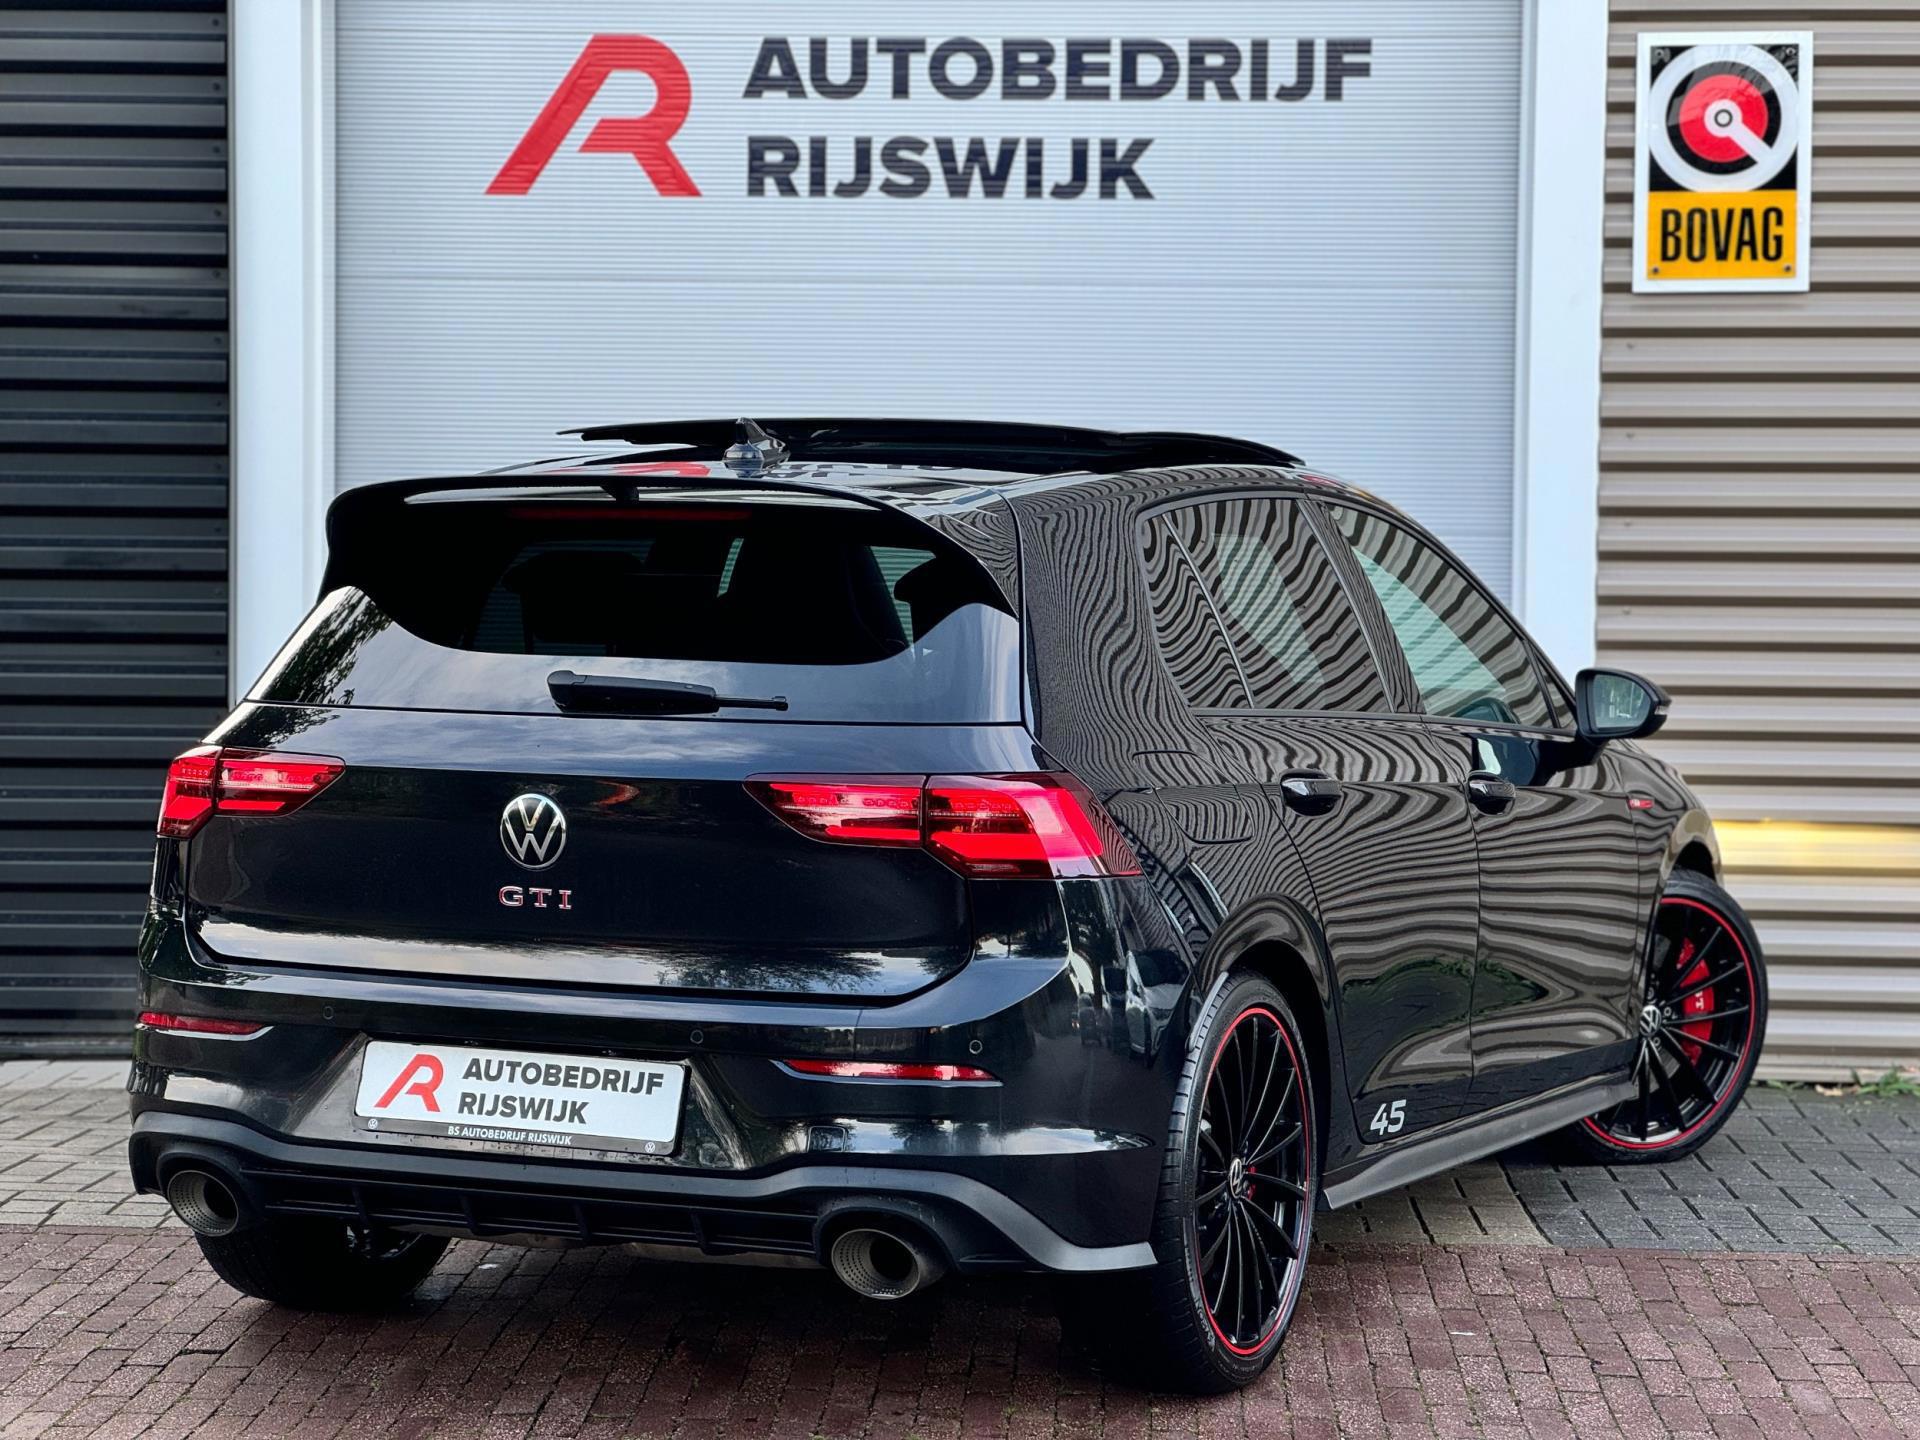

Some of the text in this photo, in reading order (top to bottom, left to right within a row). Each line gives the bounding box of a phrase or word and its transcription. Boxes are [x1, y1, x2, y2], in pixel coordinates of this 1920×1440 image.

[742, 36, 1372, 101] AUTOBEDRIJF
[747, 136, 1155, 199] RIJSWIJK
[1660, 206, 1783, 262] BOVAG
[498, 885, 572, 909] GTI
[462, 1058, 664, 1095] AUTOBEDRIJF
[457, 1092, 590, 1124] RIJSWIJK
[1370, 1099, 1407, 1135] 45
[447, 1125, 572, 1145] BS AUTOBEDRIJF RIJSWIJK
